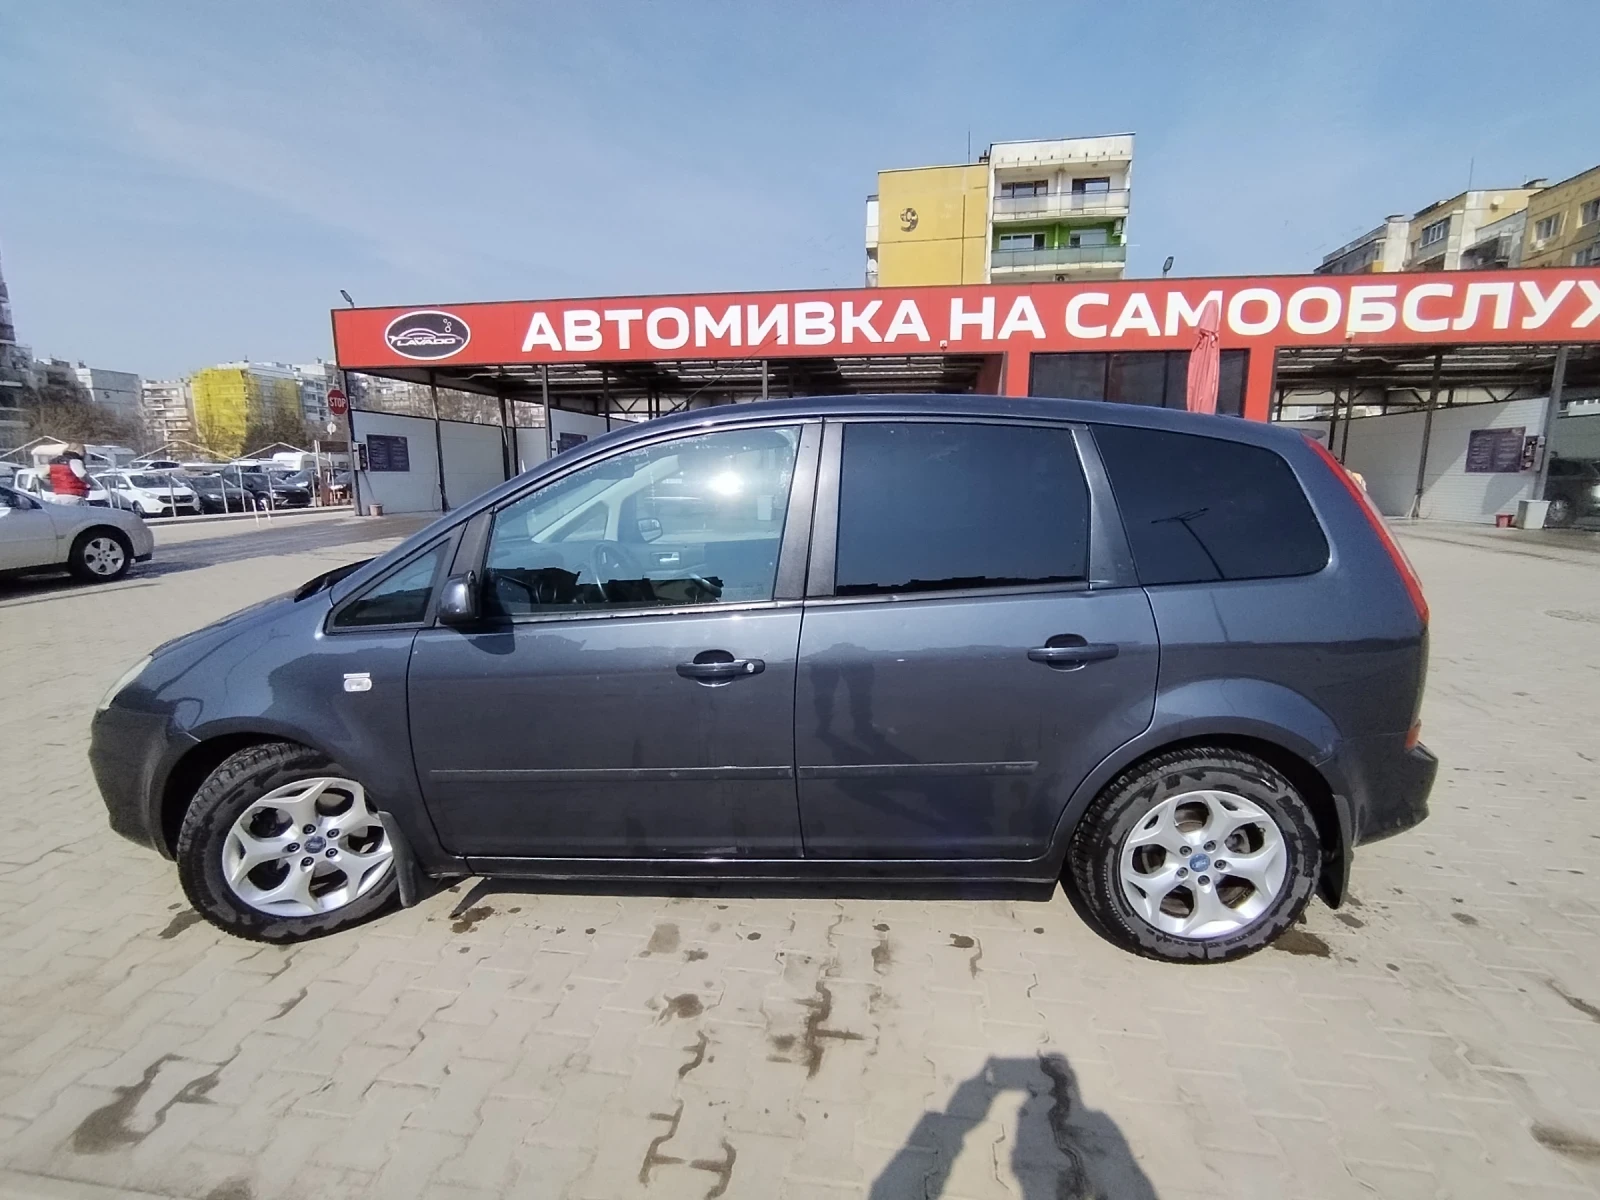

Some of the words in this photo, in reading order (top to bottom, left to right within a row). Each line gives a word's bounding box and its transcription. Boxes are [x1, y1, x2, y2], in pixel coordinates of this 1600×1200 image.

[900, 207, 918, 232] 9
[522, 299, 930, 352] АВТОМИВКА
[949, 295, 1047, 342] НА
[329, 396, 346, 408] STOP
